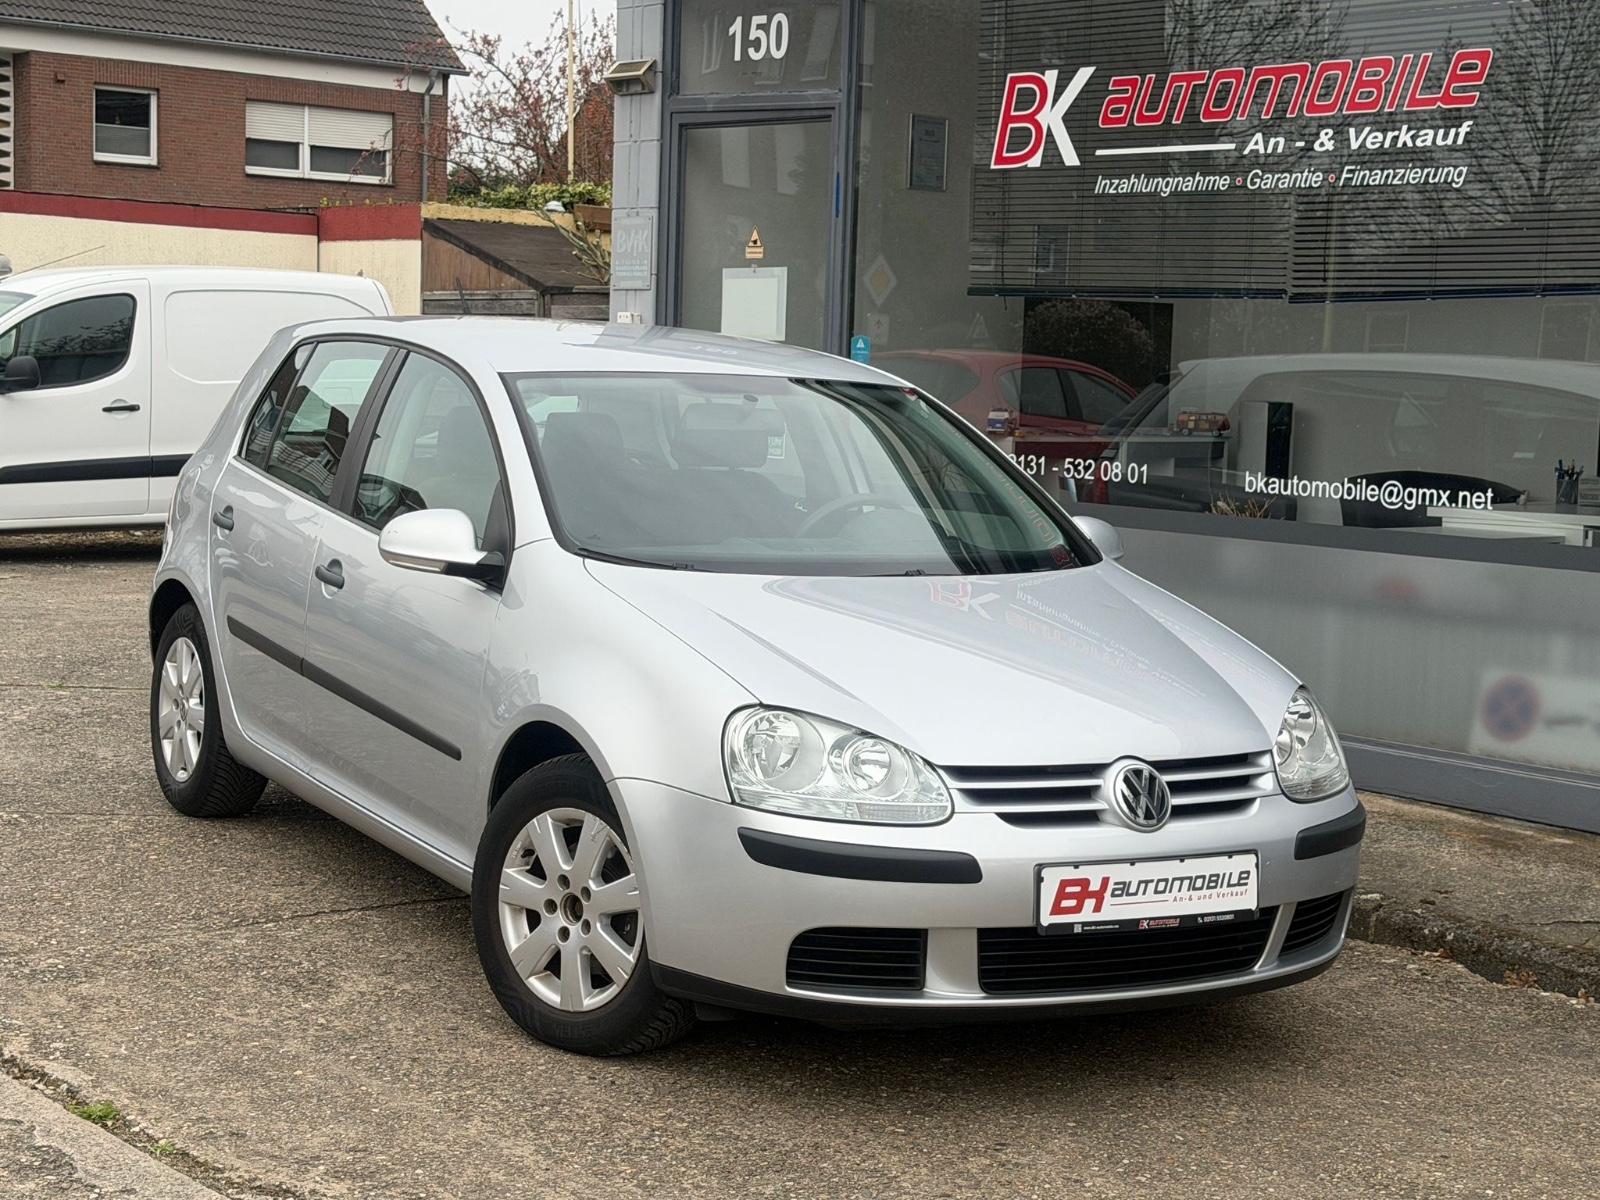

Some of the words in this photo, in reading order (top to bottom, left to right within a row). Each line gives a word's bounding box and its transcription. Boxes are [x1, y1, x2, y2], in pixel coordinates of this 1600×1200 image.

[728, 12, 789, 62] 150
[990, 66, 1097, 169] BK
[1243, 132, 1285, 155] An
[1313, 128, 1336, 152] &
[1348, 121, 1474, 150] Verkauf
[1094, 171, 1230, 197] Inzahlungnahme
[1246, 167, 1324, 190] Garantie
[1339, 163, 1468, 188] Finanzierung
[1063, 458, 1096, 480] 532
[1100, 460, 1122, 483] 08
[1127, 462, 1148, 485] 01
[1244, 471, 1494, 510] bkautomobile@gmx.net
[1049, 876, 1110, 916] BK
[1216, 889, 1248, 898] Verkauf
